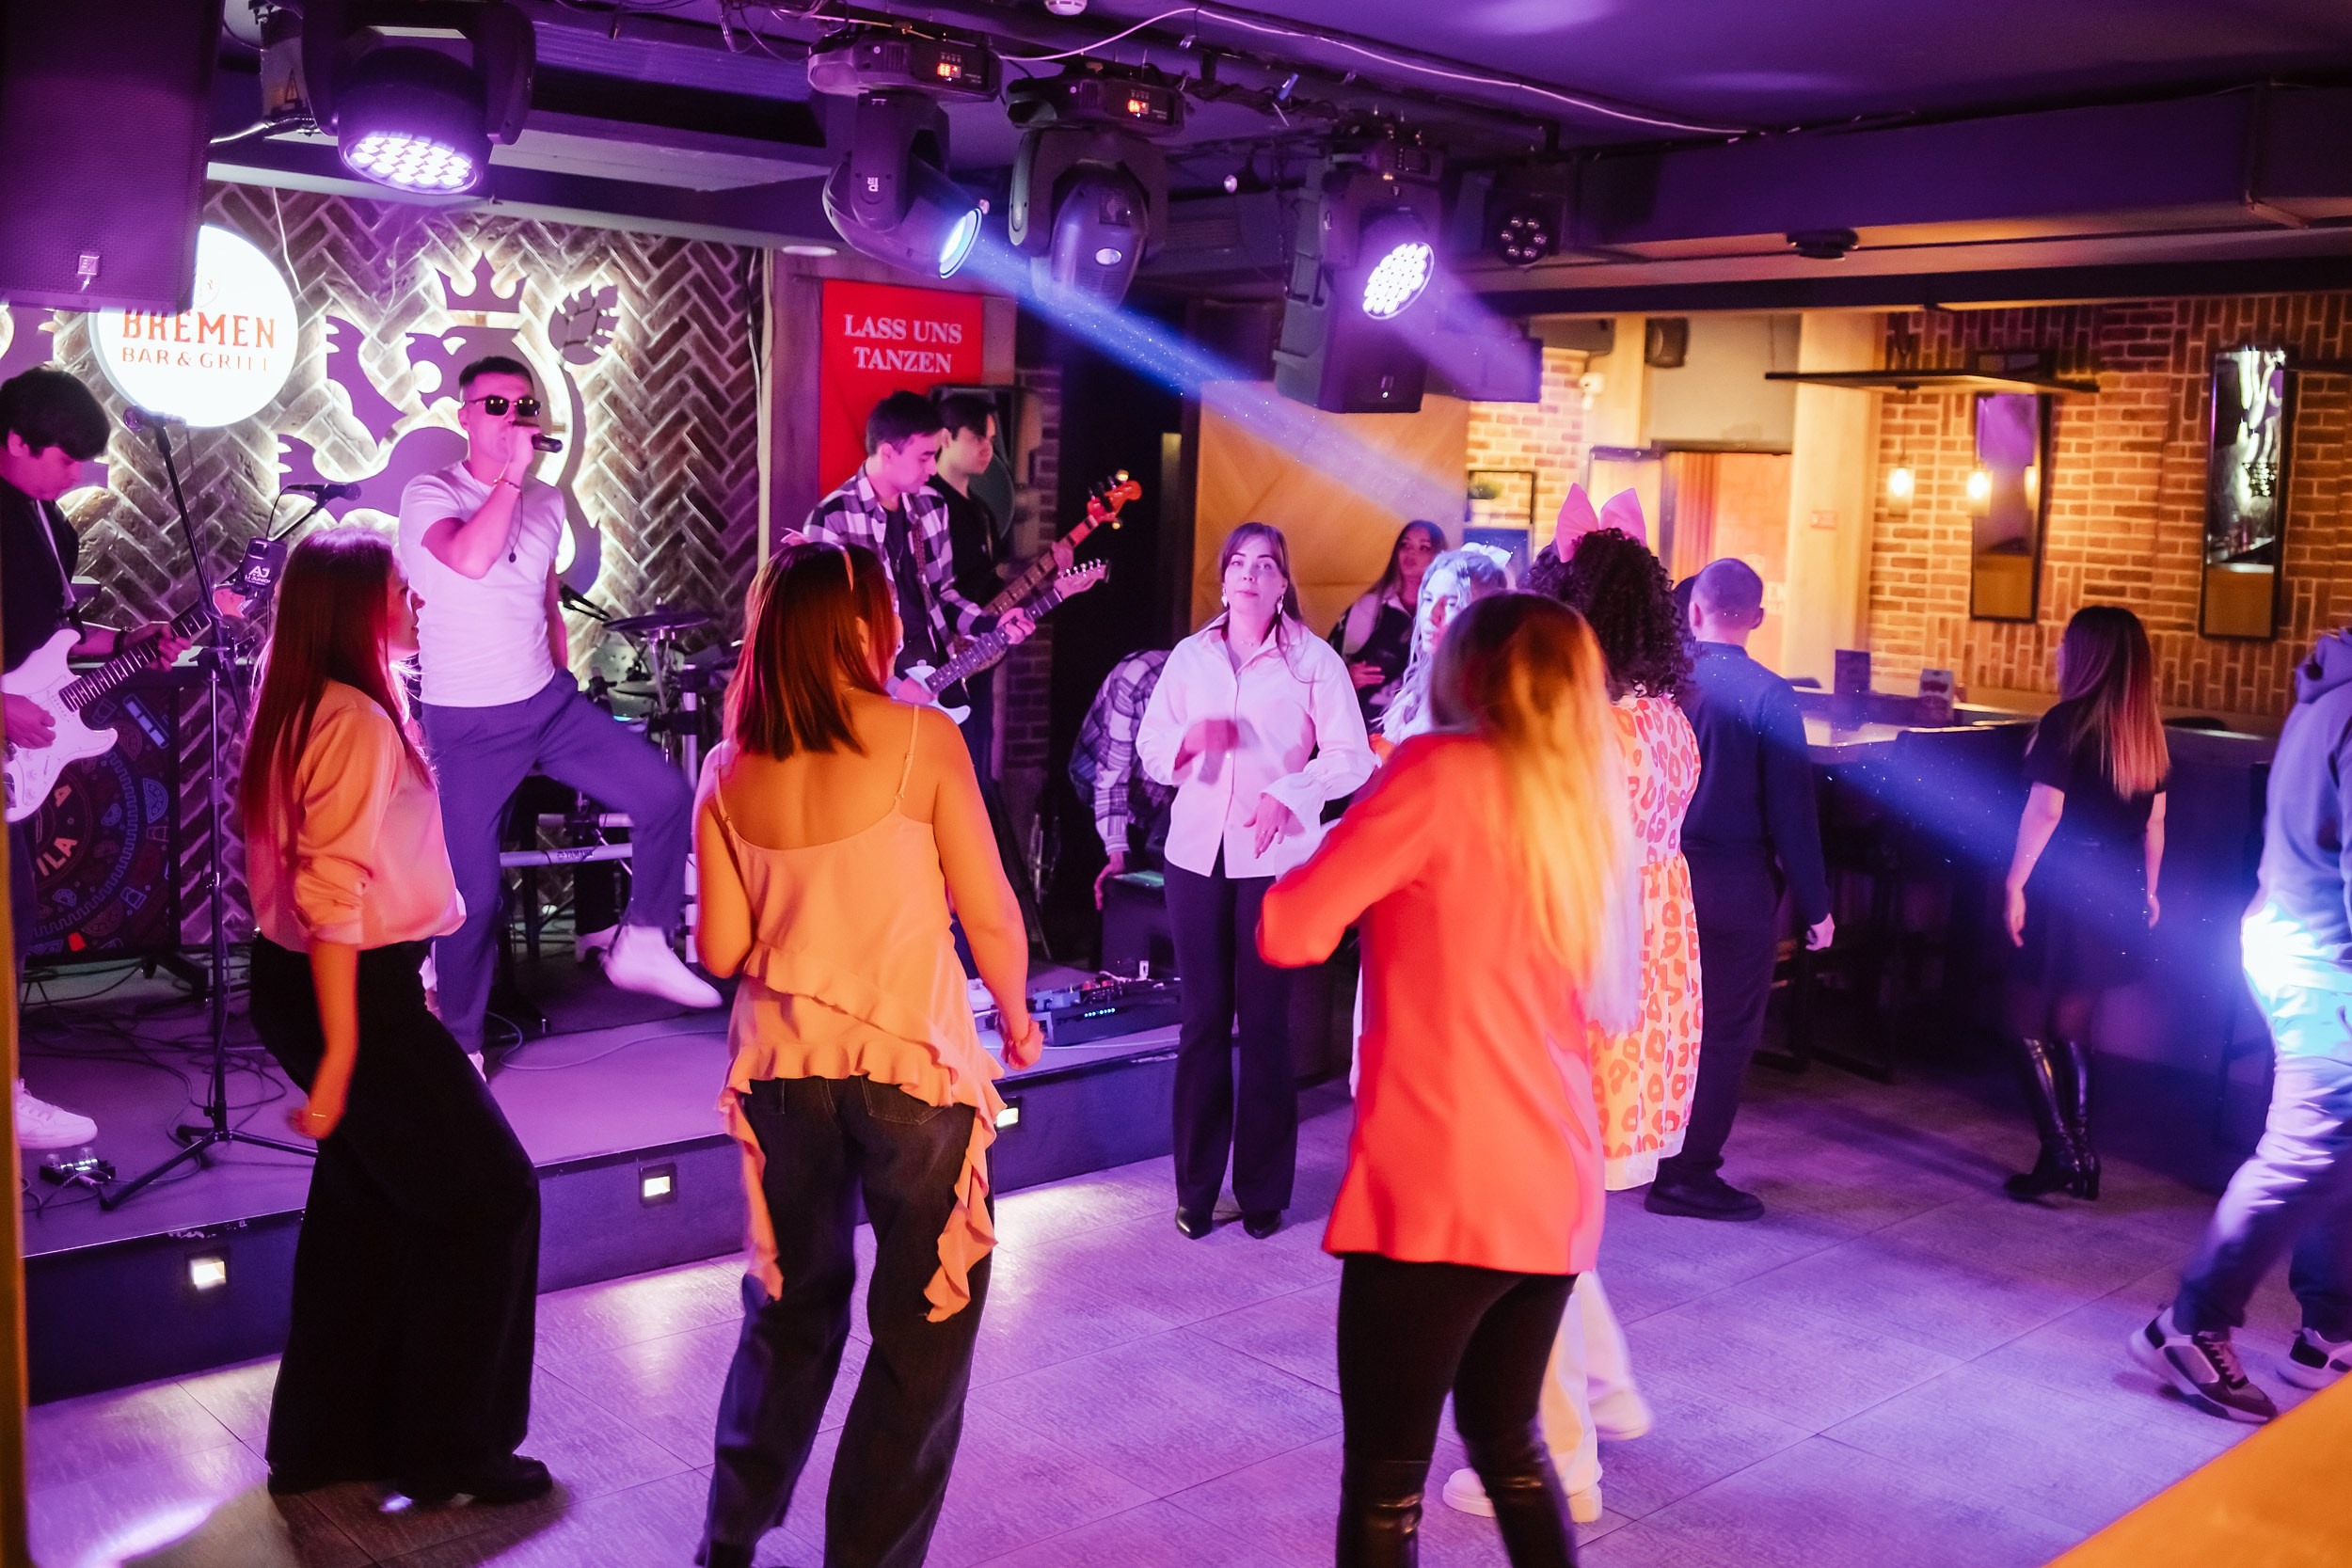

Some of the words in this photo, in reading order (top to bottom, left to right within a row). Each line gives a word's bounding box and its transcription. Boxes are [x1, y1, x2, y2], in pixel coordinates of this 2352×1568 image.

[122, 309, 275, 349] BREMEN
[844, 313, 907, 341] LASS
[913, 320, 962, 344] UNS
[122, 346, 168, 365] BAR
[853, 346, 952, 373] TANZEN
